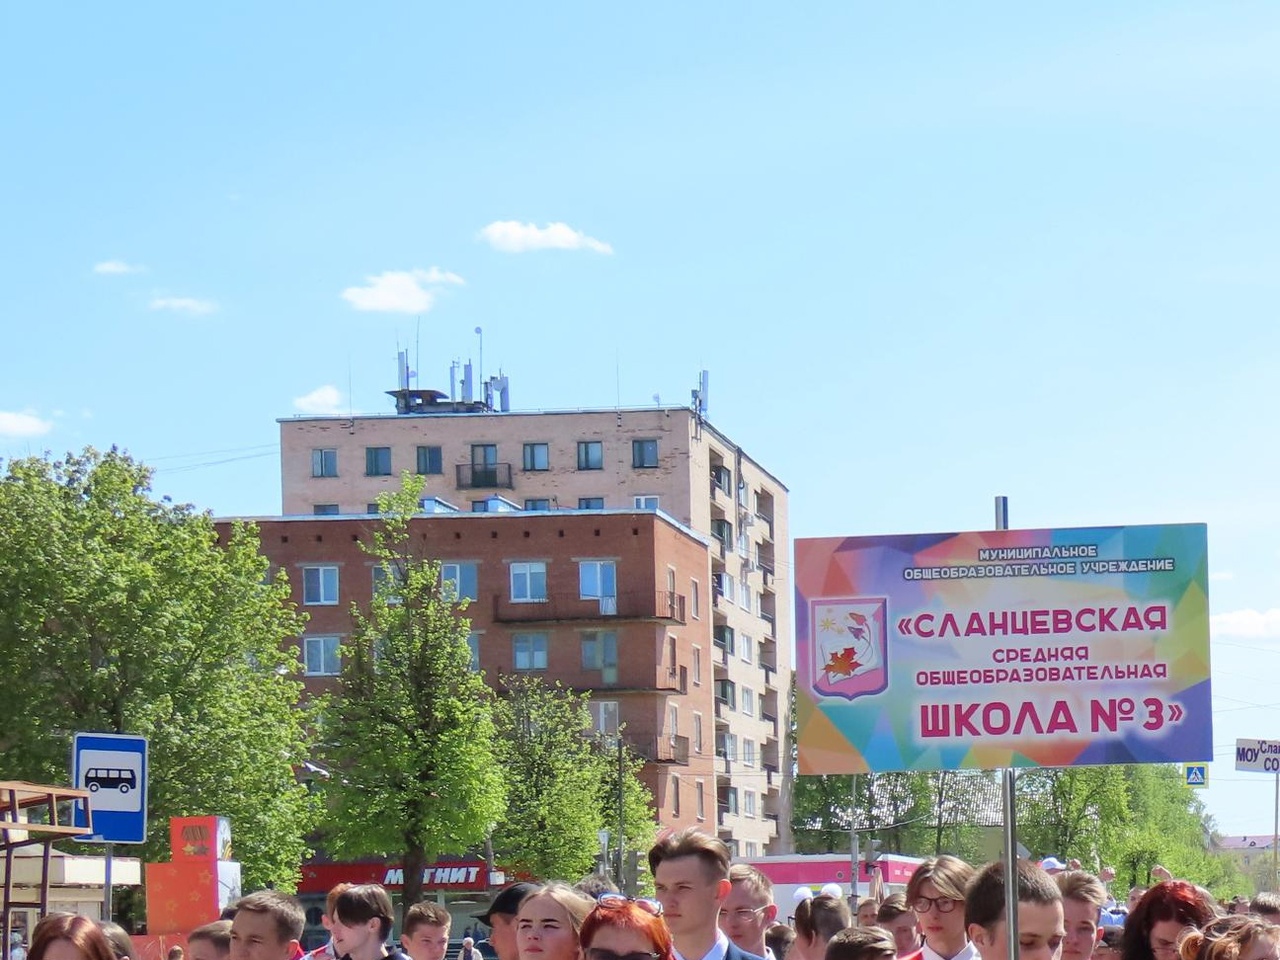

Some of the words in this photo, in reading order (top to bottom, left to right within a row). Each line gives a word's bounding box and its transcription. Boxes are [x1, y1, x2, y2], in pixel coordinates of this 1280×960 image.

[979, 545, 1098, 561] МУНИЦИПАЛЬНОЕ
[903, 562, 1076, 580] ОБЩЕОБРАЗОВАТЕЛЬНОЕ
[1082, 559, 1175, 574] УЧРЕЖДЕНИЕ
[898, 606, 1167, 638] «СЛАНЦЕВСКАЯ
[992, 646, 1089, 663] СРЕДНЯЯ
[916, 663, 1167, 686] ОБЩЕОБРАЗОВАТЕЛЬНАЯ
[920, 700, 1078, 738] ШКОЛА
[1236, 747, 1259, 763] МОУ
[383, 866, 480, 885] МГНИТ
